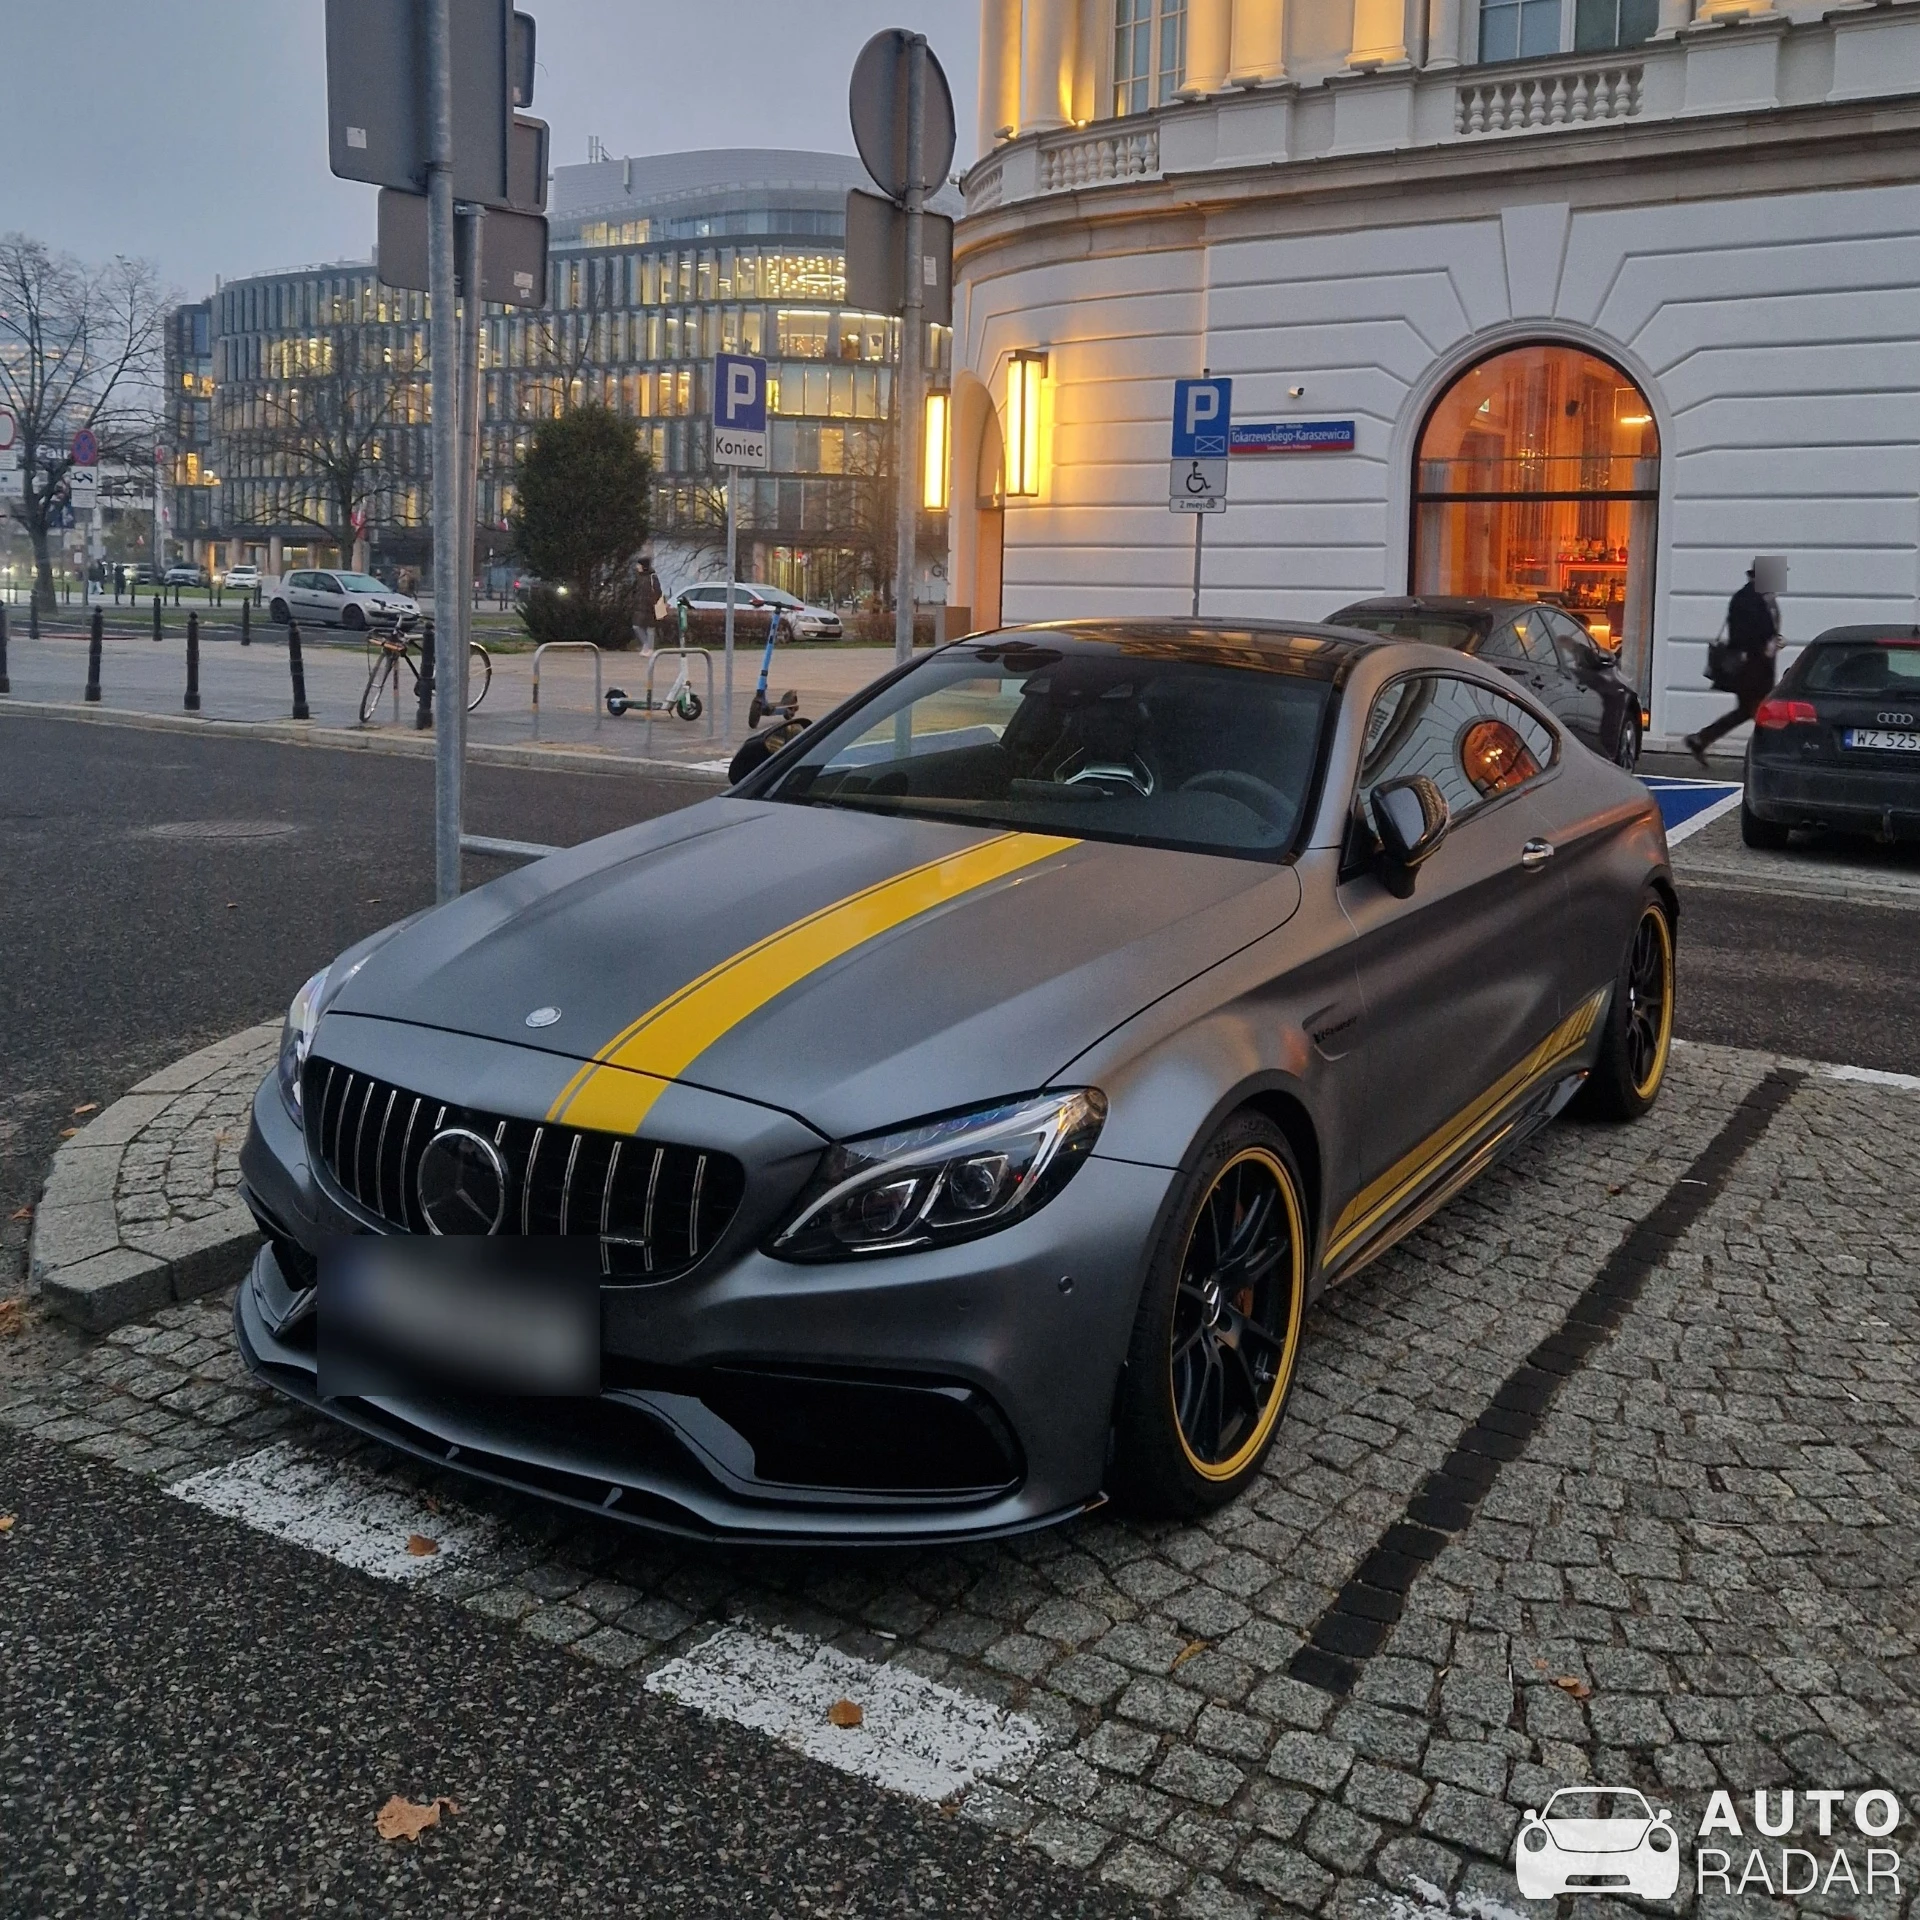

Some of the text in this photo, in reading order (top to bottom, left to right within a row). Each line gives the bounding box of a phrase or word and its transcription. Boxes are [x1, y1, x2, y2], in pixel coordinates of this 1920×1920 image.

[727, 362, 757, 420] P
[1185, 385, 1220, 434] P
[715, 437, 763, 457] Koniec
[1857, 730, 1920, 750] WZ 525
